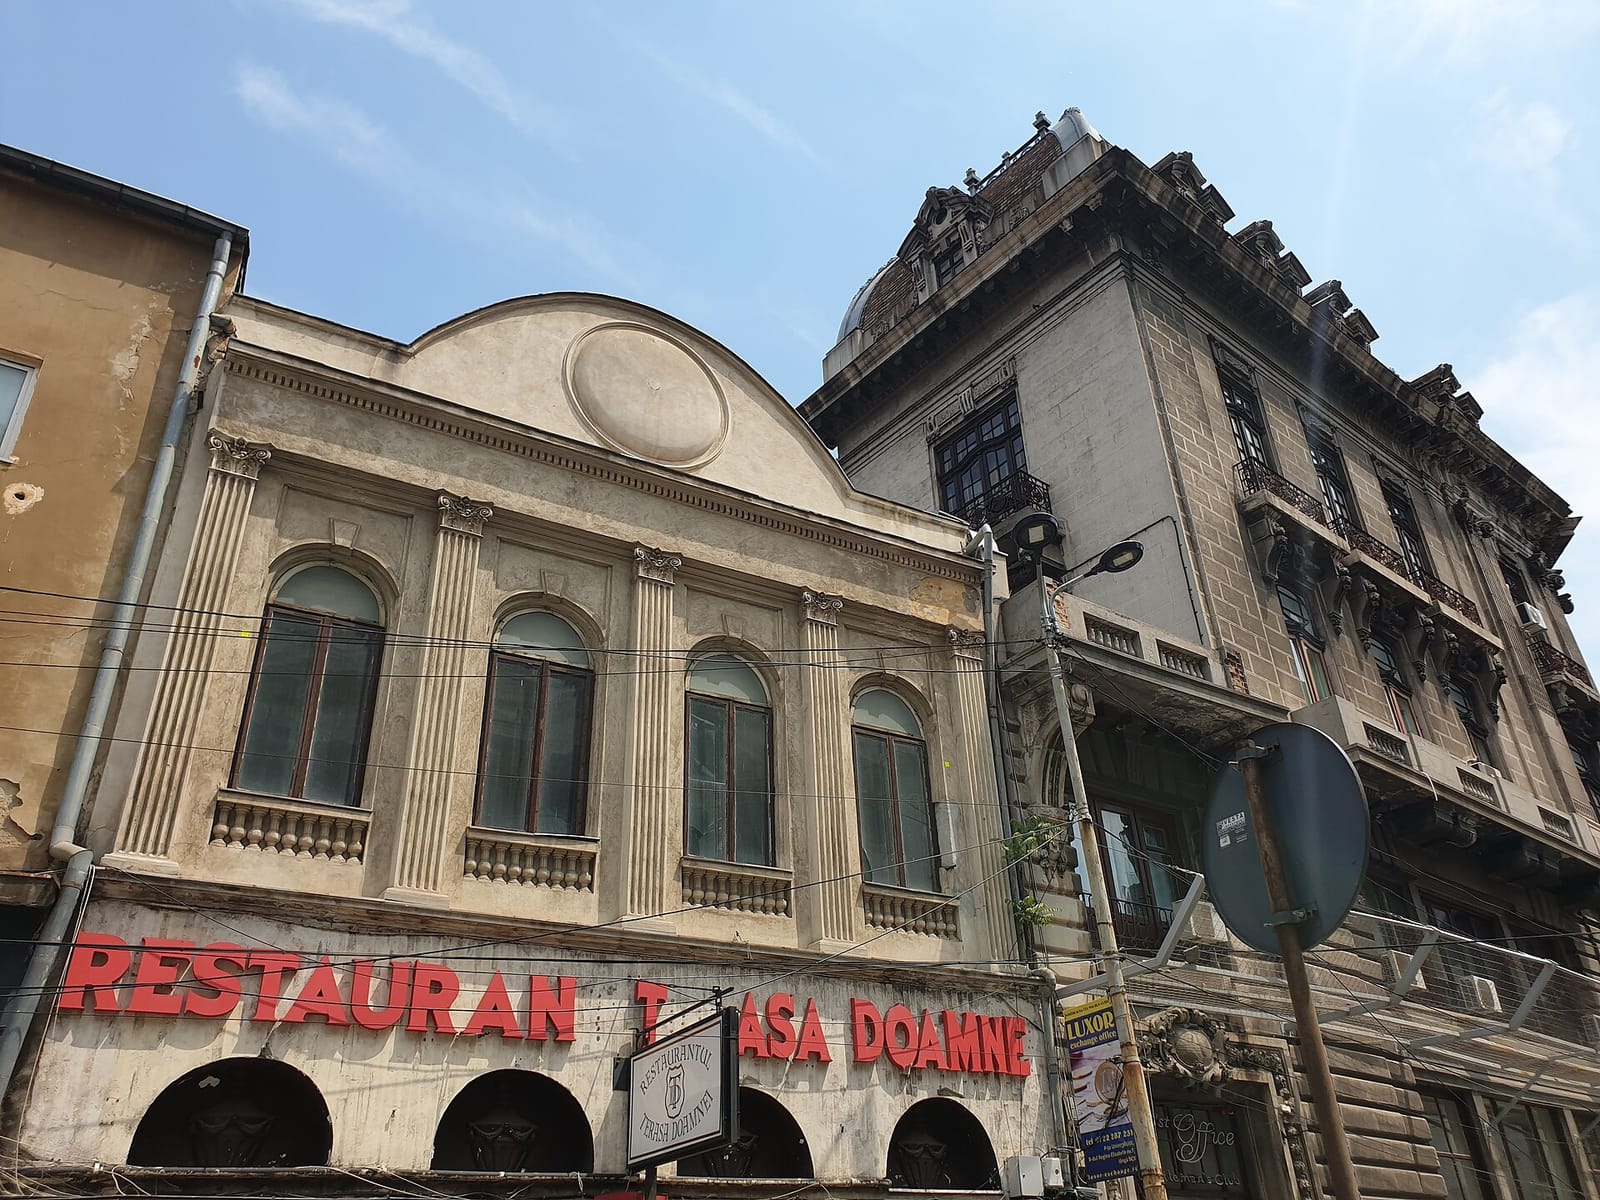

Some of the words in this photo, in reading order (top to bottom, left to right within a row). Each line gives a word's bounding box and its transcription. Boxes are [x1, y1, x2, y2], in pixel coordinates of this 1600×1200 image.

[59, 931, 577, 1042] RESTAURAN
[850, 997, 1031, 1077] DOAMNE
[1067, 1011, 1115, 1041] LUXOR
[1070, 1036, 1098, 1050] exchange
[1099, 1030, 1117, 1042] office
[640, 1043, 712, 1095] RESTAURANTUL
[639, 1112, 668, 1142] TERASA
[671, 1090, 713, 1141] DOAMNEI
[1172, 1113, 1235, 1163] Office
